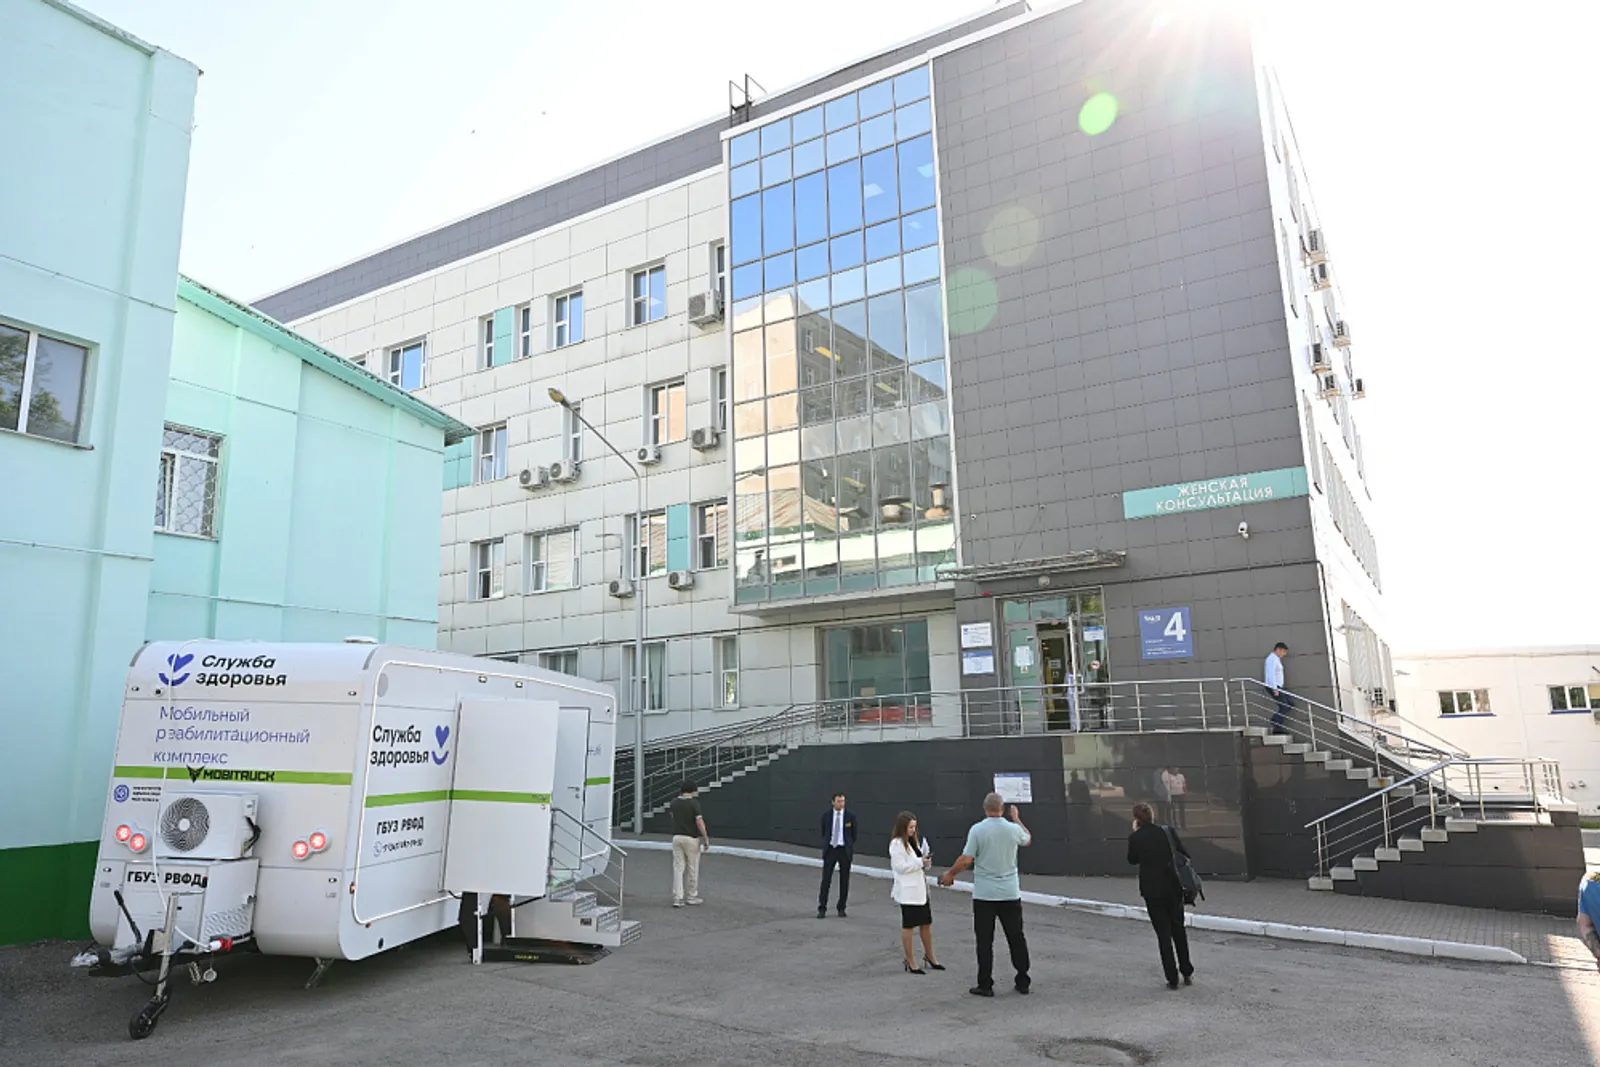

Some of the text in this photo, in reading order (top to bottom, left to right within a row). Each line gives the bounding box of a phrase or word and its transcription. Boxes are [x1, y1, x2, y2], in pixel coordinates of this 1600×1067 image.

[1177, 477, 1249, 498] ЖЕНСКАЯ
[1156, 486, 1274, 513] КОНСУЛЬТАЦИЯ
[1164, 611, 1187, 642] 4
[201, 654, 276, 671] Служба
[195, 672, 287, 688] здоровья
[160, 706, 250, 722] Мобильный
[372, 724, 422, 747] Служба
[153, 751, 228, 765] комплекс
[370, 751, 429, 768] здоровья
[203, 769, 276, 782] MOBITRUCK
[376, 819, 399, 835] ГБУЗ
